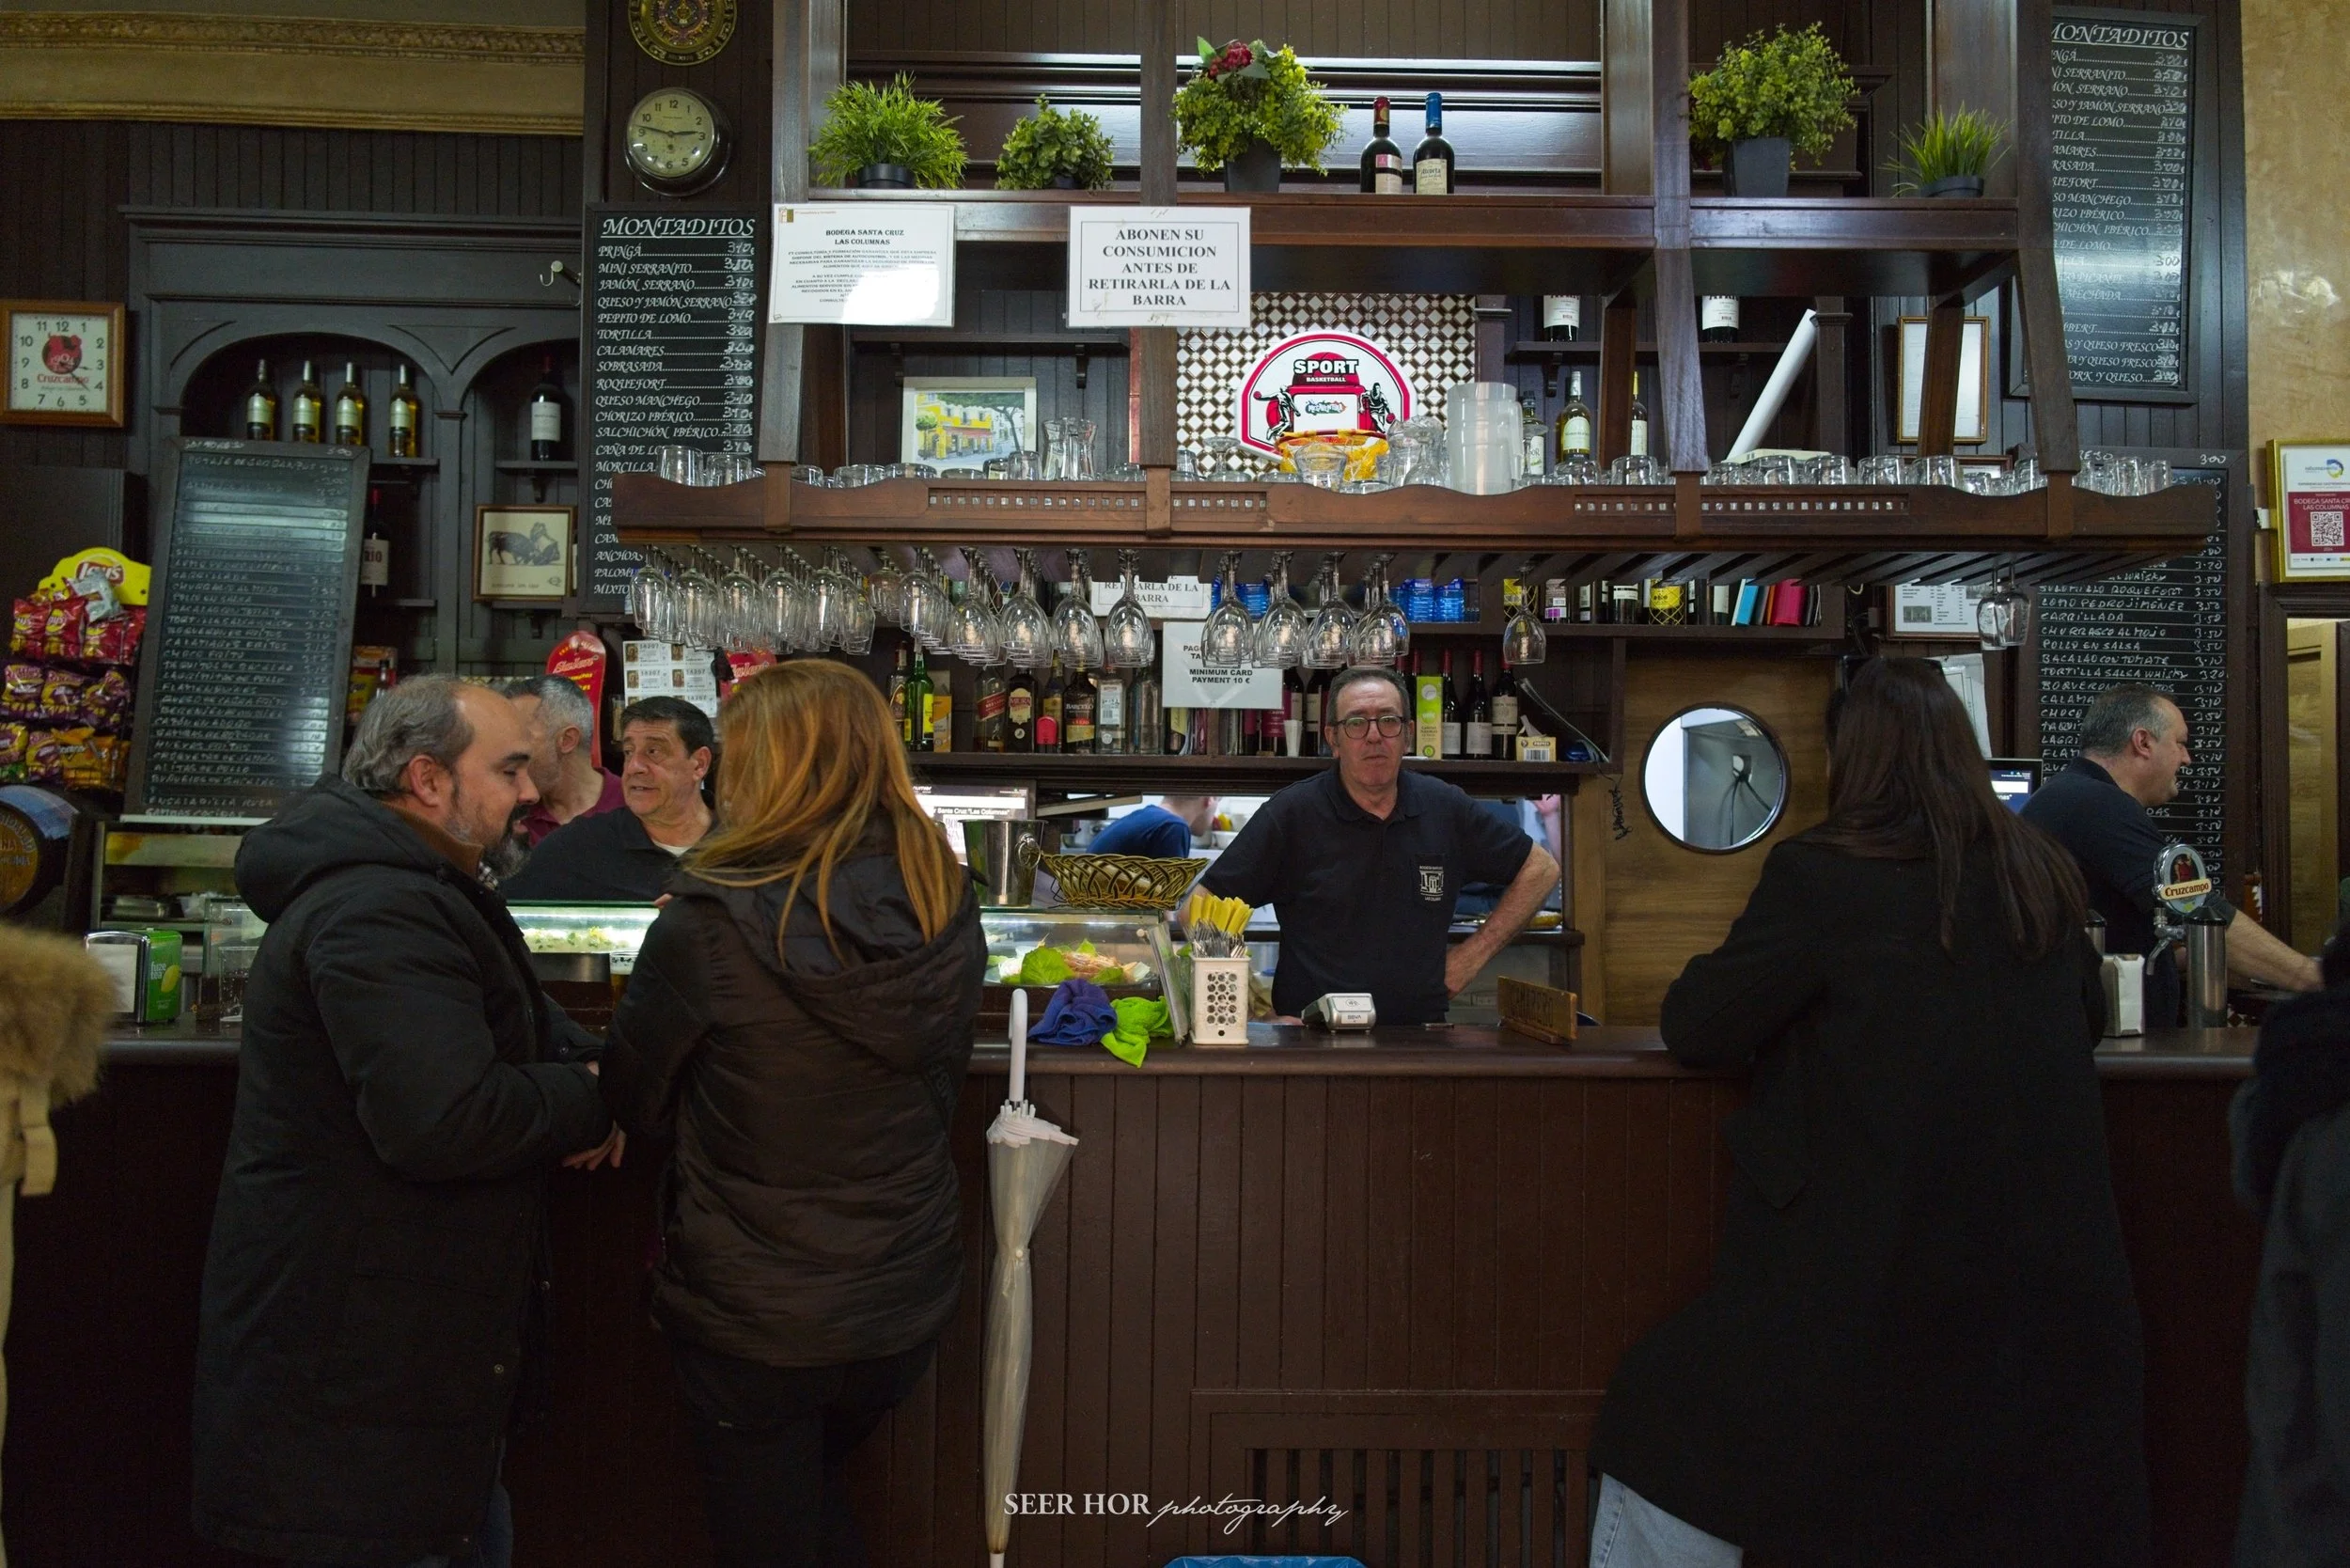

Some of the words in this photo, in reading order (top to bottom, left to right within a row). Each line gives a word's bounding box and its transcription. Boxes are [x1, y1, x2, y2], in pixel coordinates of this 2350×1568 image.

[2063, 68, 2126, 81] SERRANITO
[2076, 84, 2128, 97] SERRANO
[655, 103, 662, 112] 11
[669, 100, 679, 108] 12
[2069, 101, 2077, 110] Y
[2078, 100, 2117, 112] JAMÓN
[2117, 103, 2165, 115] SERRANO
[642, 114, 651, 122] 10
[696, 117, 702, 125] 2
[2074, 116, 2091, 125] DE
[2092, 118, 2123, 127] LOMO
[666, 161, 673, 169] 6
[2068, 194, 2131, 207] MANCHEGO
[2080, 207, 2124, 220] IBÉRICO
[603, 217, 755, 237] MONTADITOS
[2104, 225, 2149, 236] IBÉRICO
[1116, 229, 1181, 241] ABONEN
[1185, 229, 1204, 241] SU
[598, 243, 642, 259] PRINGÁ
[2060, 241, 2077, 249] DE
[2079, 242, 2110, 250] LOMO
[1103, 246, 1216, 257] CONSUMICION
[598, 262, 627, 274] MINI
[629, 262, 692, 274] SERRANITO
[1122, 263, 1172, 274] ANTES
[1178, 263, 1198, 274] DE
[599, 278, 640, 291] JAMÓN
[642, 280, 695, 291] SERRANO
[1089, 279, 1180, 290] RETIRARLA
[1185, 279, 1205, 290] DE
[1211, 279, 1230, 290] LA
[597, 297, 634, 308] QUESO
[634, 297, 644, 308] Y
[644, 296, 684, 308] JAMÓN
[684, 297, 732, 308] SERRANO
[1133, 295, 1186, 306] BARRA
[597, 313, 637, 323] PEPITO
[639, 313, 656, 323] DE
[658, 313, 691, 323] LOMO
[37, 321, 47, 331] 11
[55, 321, 70, 332] 12
[81, 322, 86, 332] 1
[597, 329, 652, 340] TORTILLA
[20, 336, 33, 347] 10
[96, 338, 104, 349] 2
[2074, 340, 2083, 350] Y
[2083, 341, 2118, 351] QUESO
[2120, 342, 2158, 352] FRESCO
[596, 345, 665, 357] CALAMARES
[22, 357, 29, 368] 9
[96, 359, 104, 370] 3
[596, 361, 663, 373] SOBRASADA
[1293, 359, 1359, 375] SPORT
[2078, 356, 2087, 365] Y
[2087, 357, 2120, 366] QUESO
[2121, 358, 2158, 368] FRESCO
[2096, 372, 2105, 382] Y
[2106, 374, 2143, 383] QUESO
[21, 378, 29, 389] 8
[94, 381, 103, 390] 4
[596, 378, 666, 391] ROQUEFORT
[38, 394, 45, 404] 7
[57, 396, 65, 407] 6
[79, 396, 86, 405] 5
[595, 396, 634, 407] QUESO
[634, 396, 700, 408] MANCHEGO
[595, 411, 646, 422] CHORIZO
[648, 410, 694, 423] IBÉRICO
[596, 425, 669, 439] SALCHICHÓN
[673, 425, 718, 438] IBÉRICO
[596, 443, 627, 456] CAÑA
[628, 446, 645, 455] DE
[595, 462, 653, 474] MORCILLA
[1185, 584, 1198, 592] LA
[2111, 588, 2183, 596] ROQUEFORT
[1133, 594, 1169, 603] BARRA
[2041, 598, 2076, 607] LOMO
[2080, 599, 2124, 608] PEDRO
[2043, 640, 2078, 649] POLLO
[2104, 642, 2140, 651] SALSA
[2165, 880, 2210, 898] Cruzcampo
